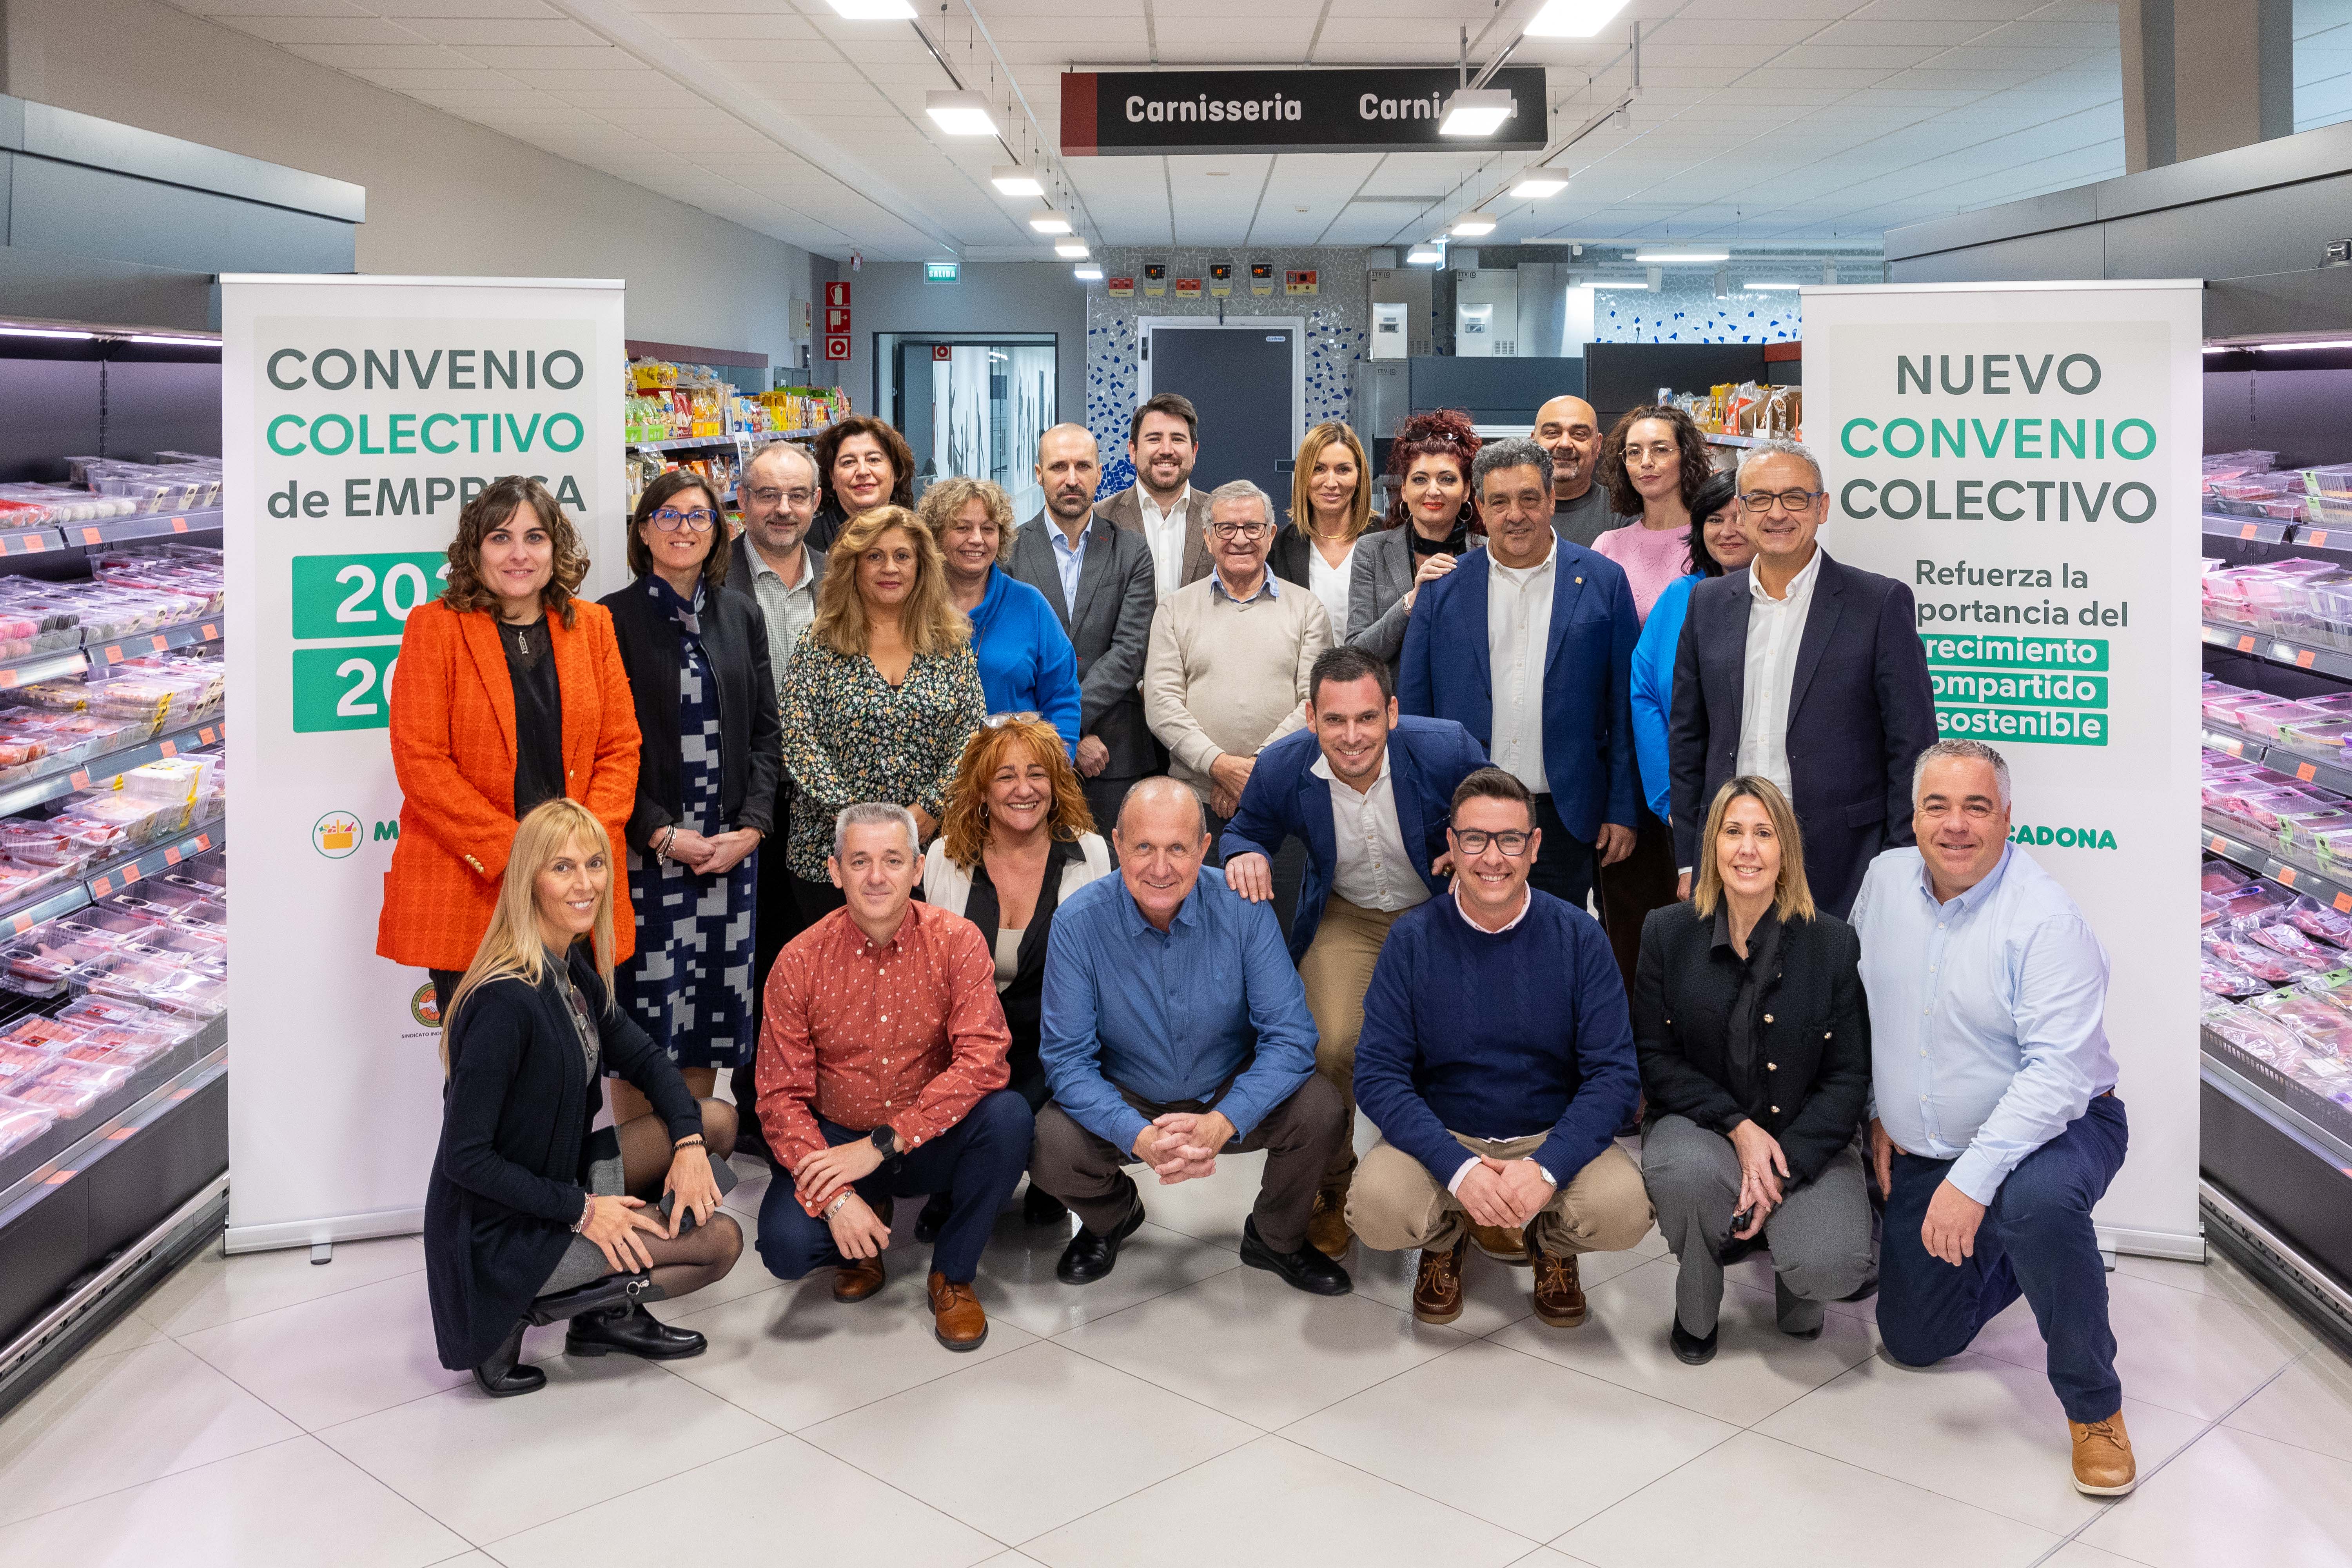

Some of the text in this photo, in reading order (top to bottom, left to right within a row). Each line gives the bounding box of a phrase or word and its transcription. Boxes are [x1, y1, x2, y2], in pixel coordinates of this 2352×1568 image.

[1126, 93, 1301, 122] Carnisseria
[267, 348, 584, 391] CONVENIO
[1897, 353, 2102, 396] NUEVO
[267, 412, 584, 457] COLECTIVO
[1840, 417, 2157, 461] CONVENIO
[267, 475, 587, 519] de EMPRA
[1840, 479, 2157, 524] COLECTIVO
[1916, 559, 2088, 588] Refuerza la
[336, 562, 454, 623] 20
[1917, 599, 2128, 627] portancia del
[1926, 634, 2097, 664] recimiento
[1930, 673, 2096, 702] ompartido
[1936, 710, 2101, 738] sostenible
[2007, 824, 2118, 850] ADONA
